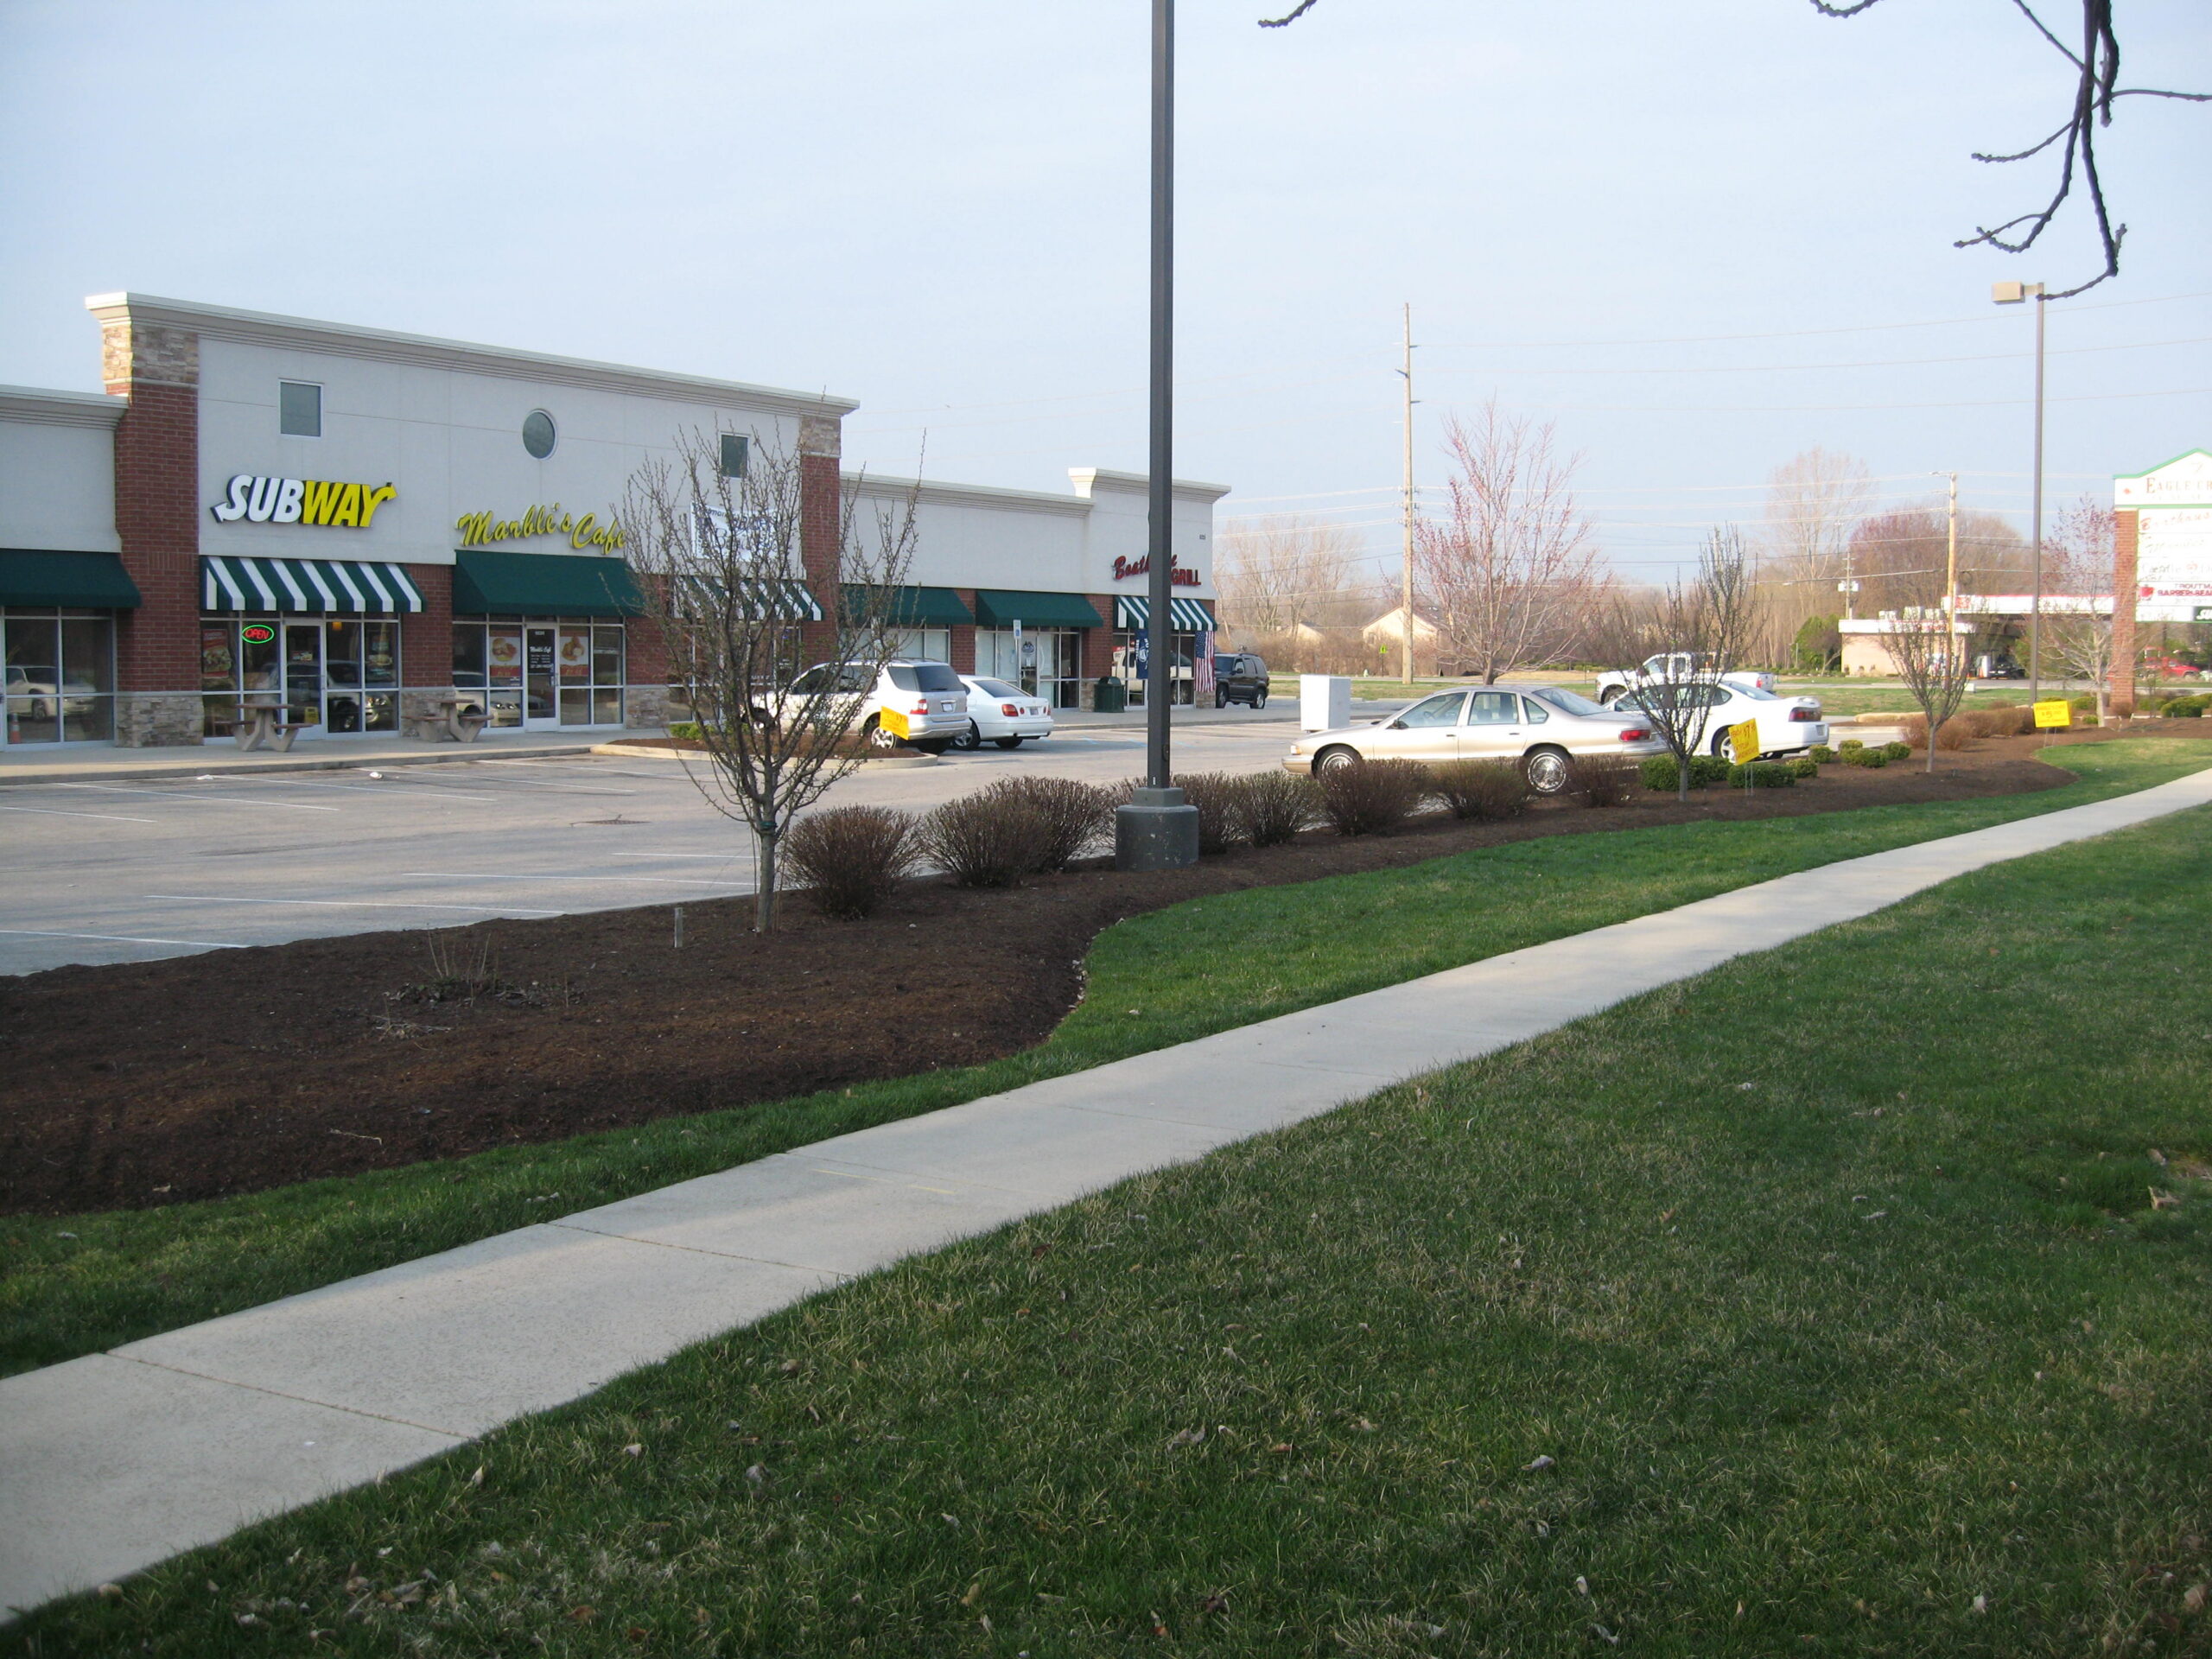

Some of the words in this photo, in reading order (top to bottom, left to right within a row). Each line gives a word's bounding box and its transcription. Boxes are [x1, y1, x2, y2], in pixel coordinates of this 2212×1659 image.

[211, 474, 398, 527] SUBWAY
[456, 502, 572, 547] Marble's
[571, 512, 626, 555] Cafe
[1112, 553, 1178, 581] Boathe
[1171, 569, 1202, 586] GRILL
[245, 629, 270, 640] OPEN
